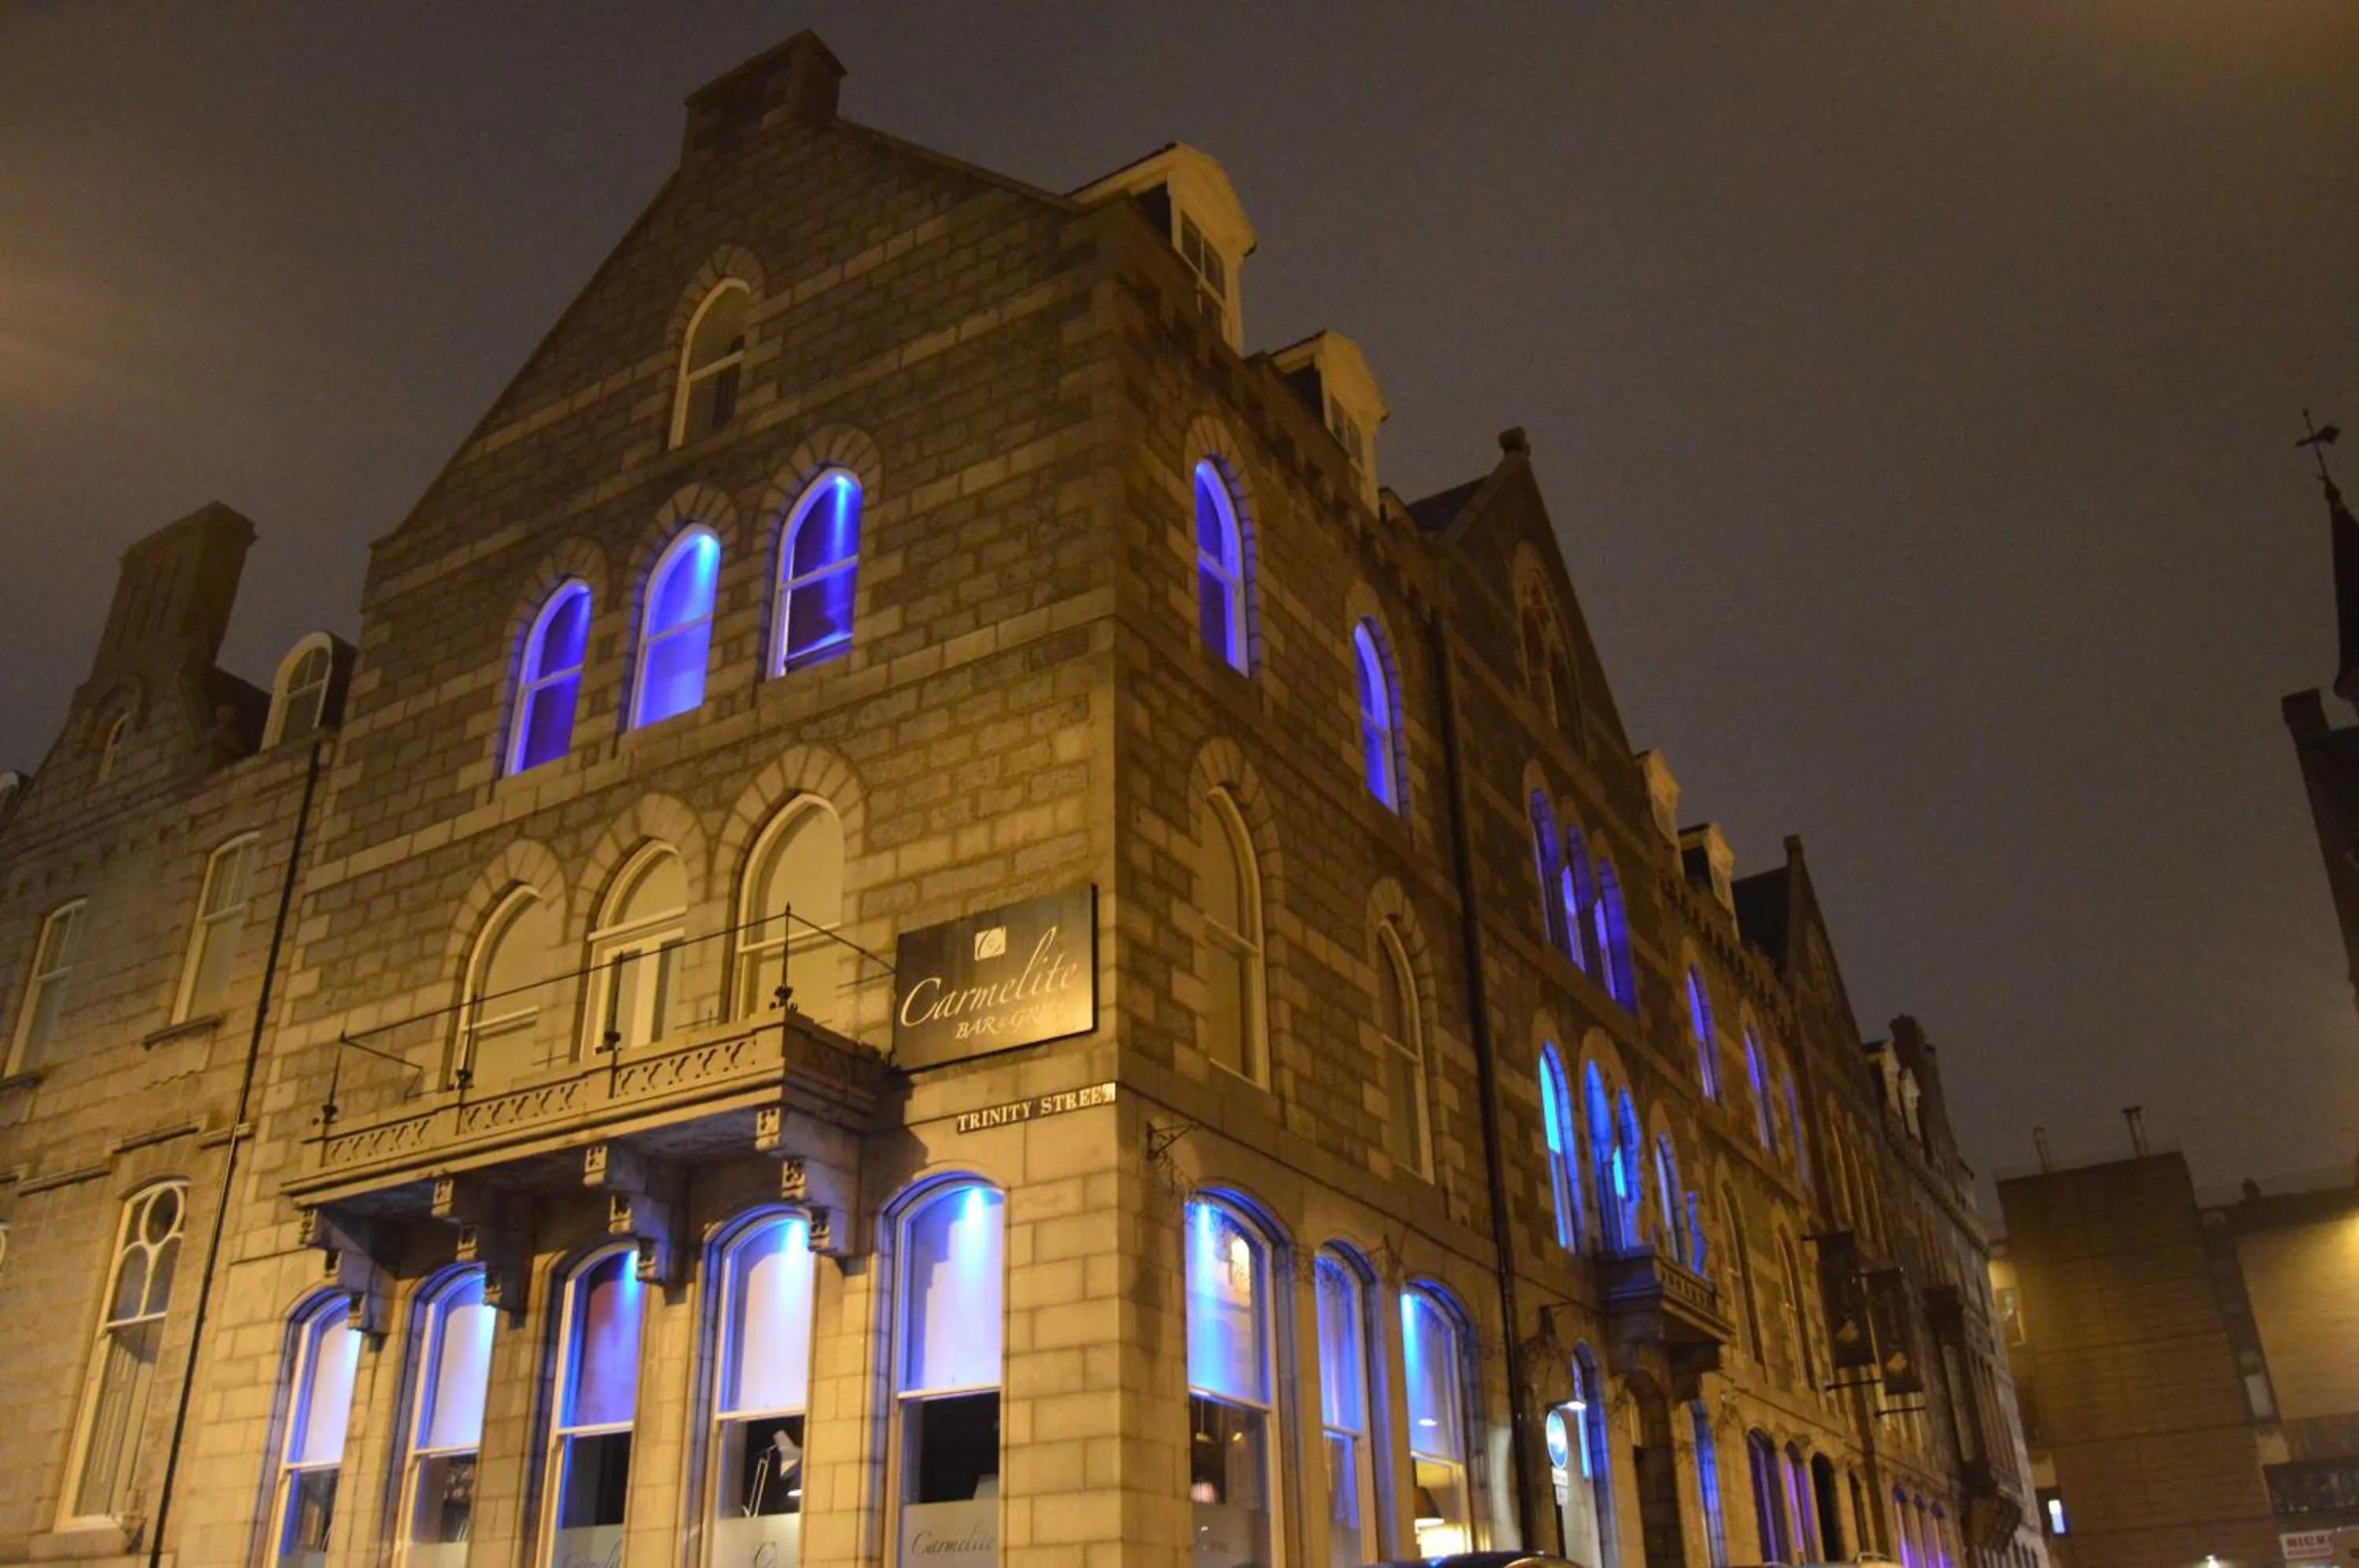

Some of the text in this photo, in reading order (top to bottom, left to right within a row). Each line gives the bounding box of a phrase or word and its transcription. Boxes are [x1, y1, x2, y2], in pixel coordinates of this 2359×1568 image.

[900, 925, 1078, 1028] Carmelite
[955, 1015, 999, 1040] BAR
[956, 1100, 1032, 1132] TRINITY
